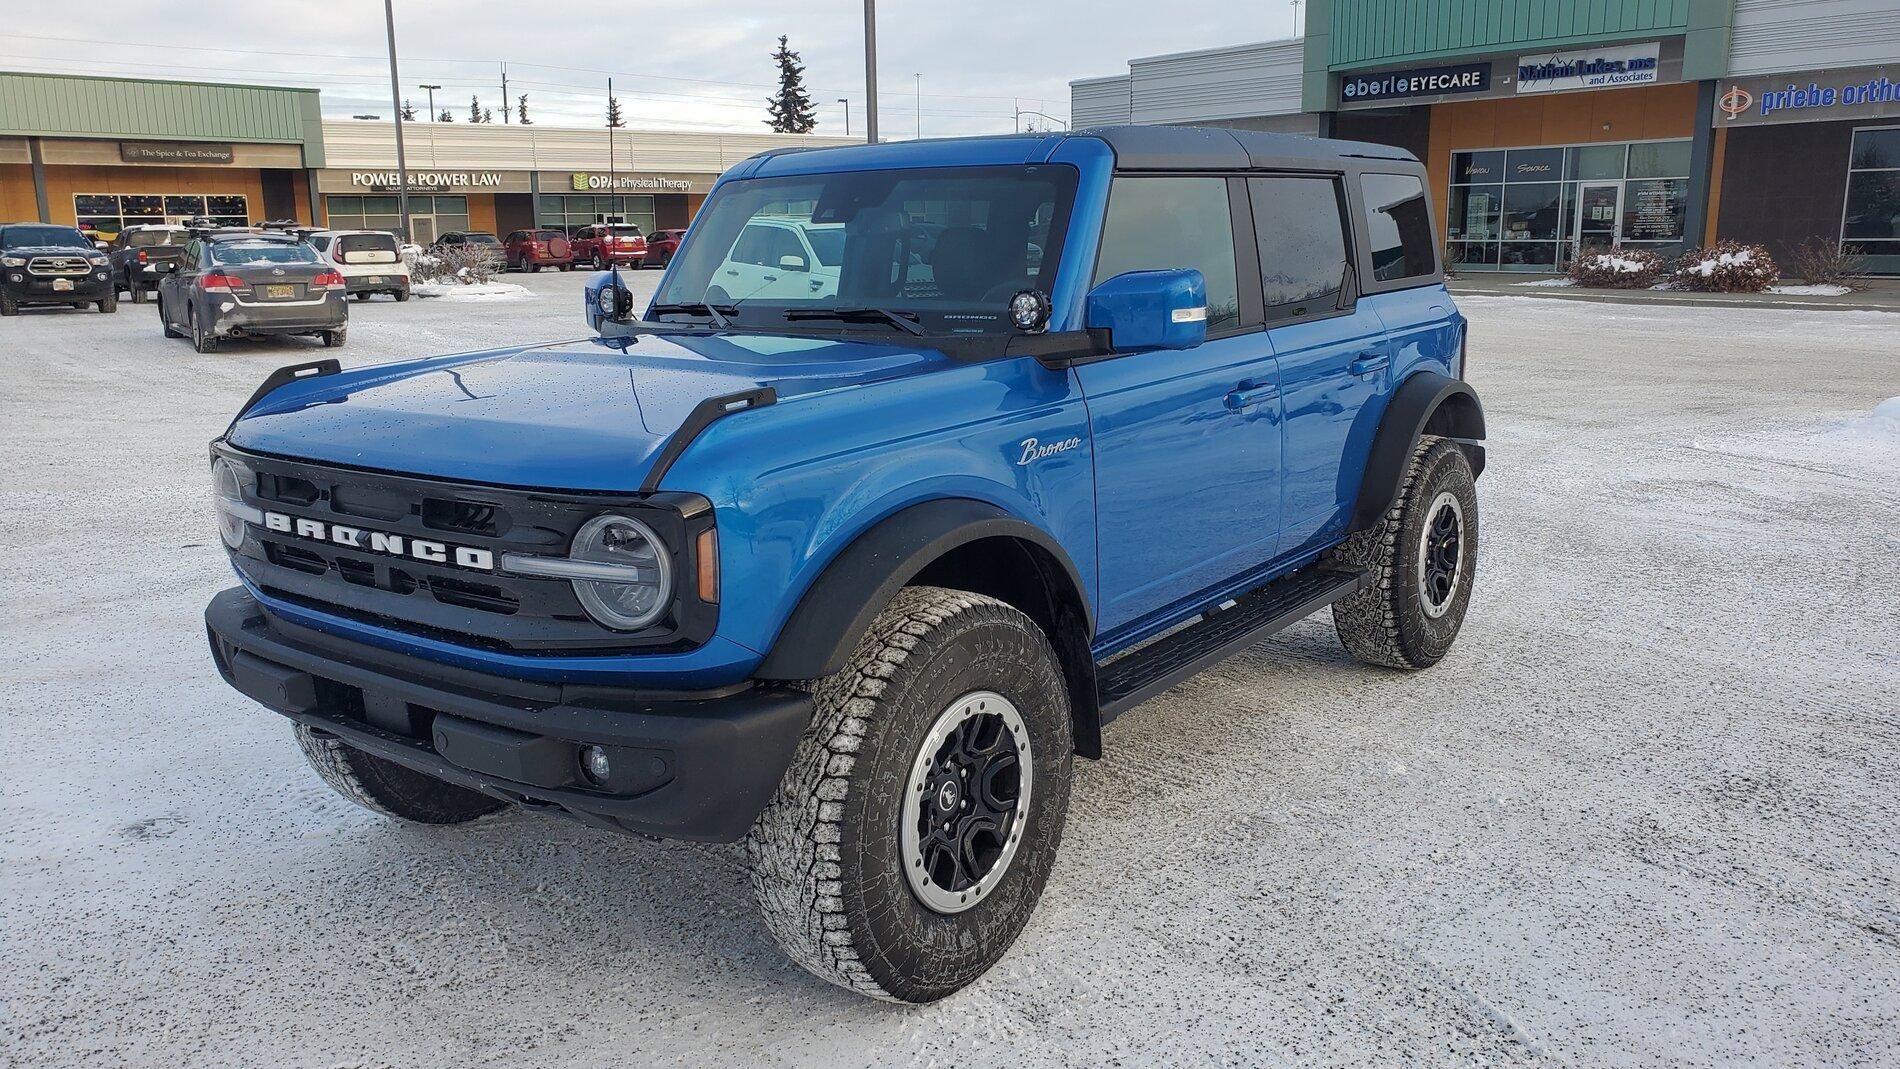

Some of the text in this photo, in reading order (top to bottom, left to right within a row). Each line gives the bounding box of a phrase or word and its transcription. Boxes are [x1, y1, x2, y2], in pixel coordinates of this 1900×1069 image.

[1628, 58, 1656, 70] DDS
[1589, 72, 1653, 85] and Associates
[1761, 83, 1837, 116] priebe
[156, 150, 175, 158] Spice
[198, 151, 230, 159] Exchange
[407, 175, 416, 185] &
[417, 173, 469, 186] POWER
[471, 173, 502, 186] LAW
[588, 175, 693, 191] OPA Physical Therapy
[1016, 436, 1082, 466] Bronco
[264, 511, 494, 570] BRONCO
